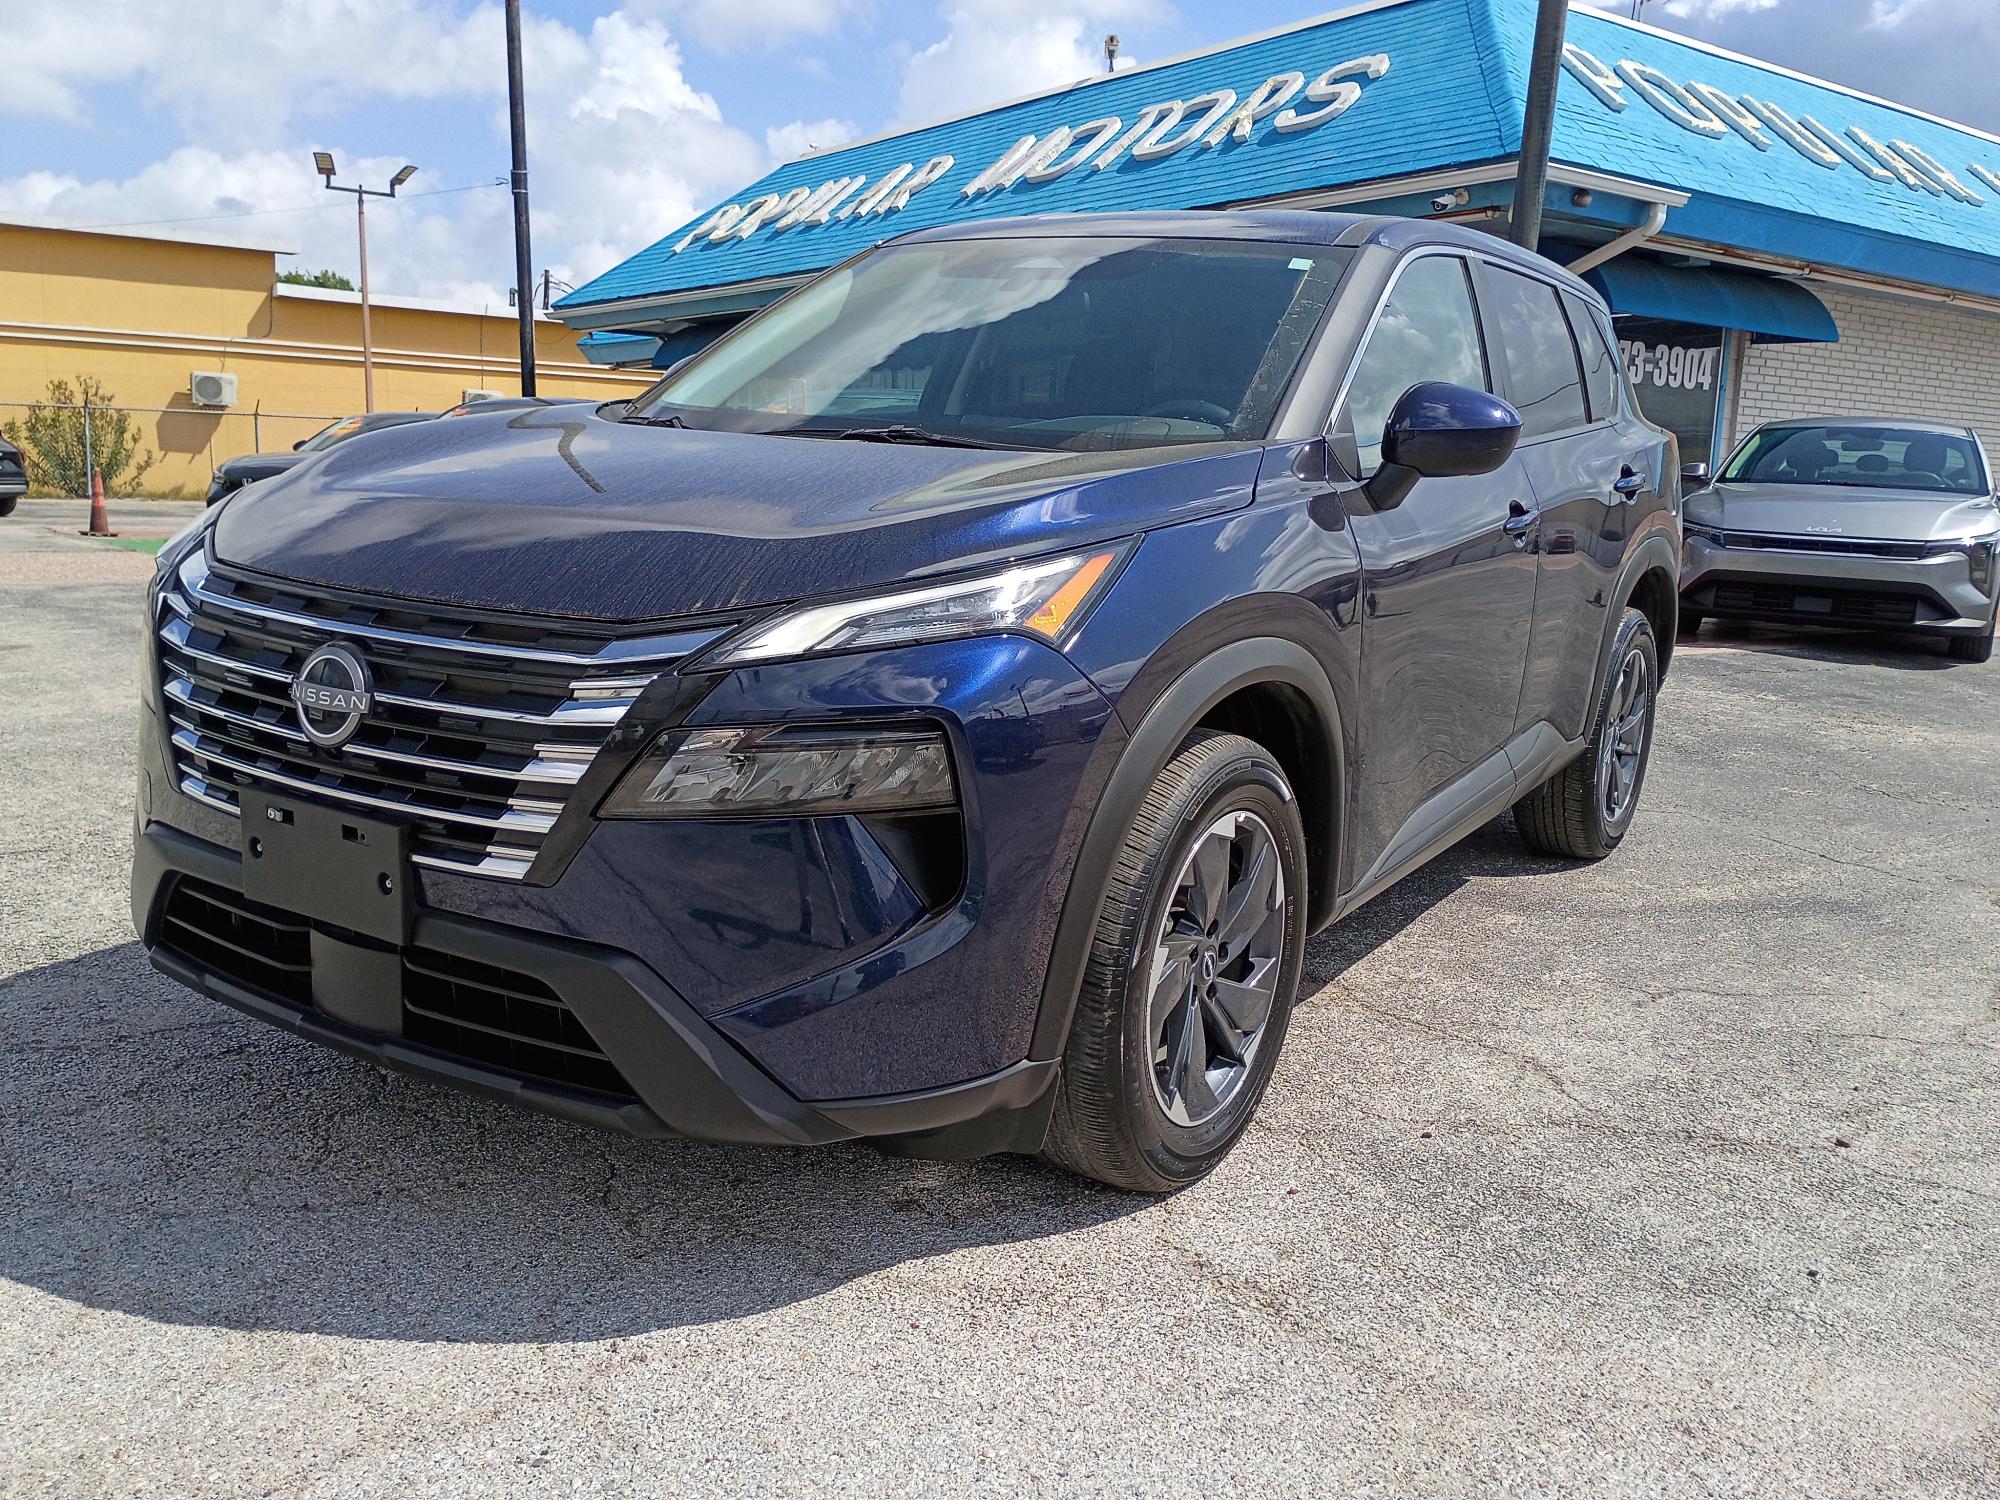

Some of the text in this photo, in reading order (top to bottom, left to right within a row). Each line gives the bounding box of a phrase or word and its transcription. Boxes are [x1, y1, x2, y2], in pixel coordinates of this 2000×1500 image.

[671, 53, 1390, 254] POPULAR MOTORS
[1561, 42, 1986, 207] POPULAR
[292, 683, 366, 710] NISSAN
